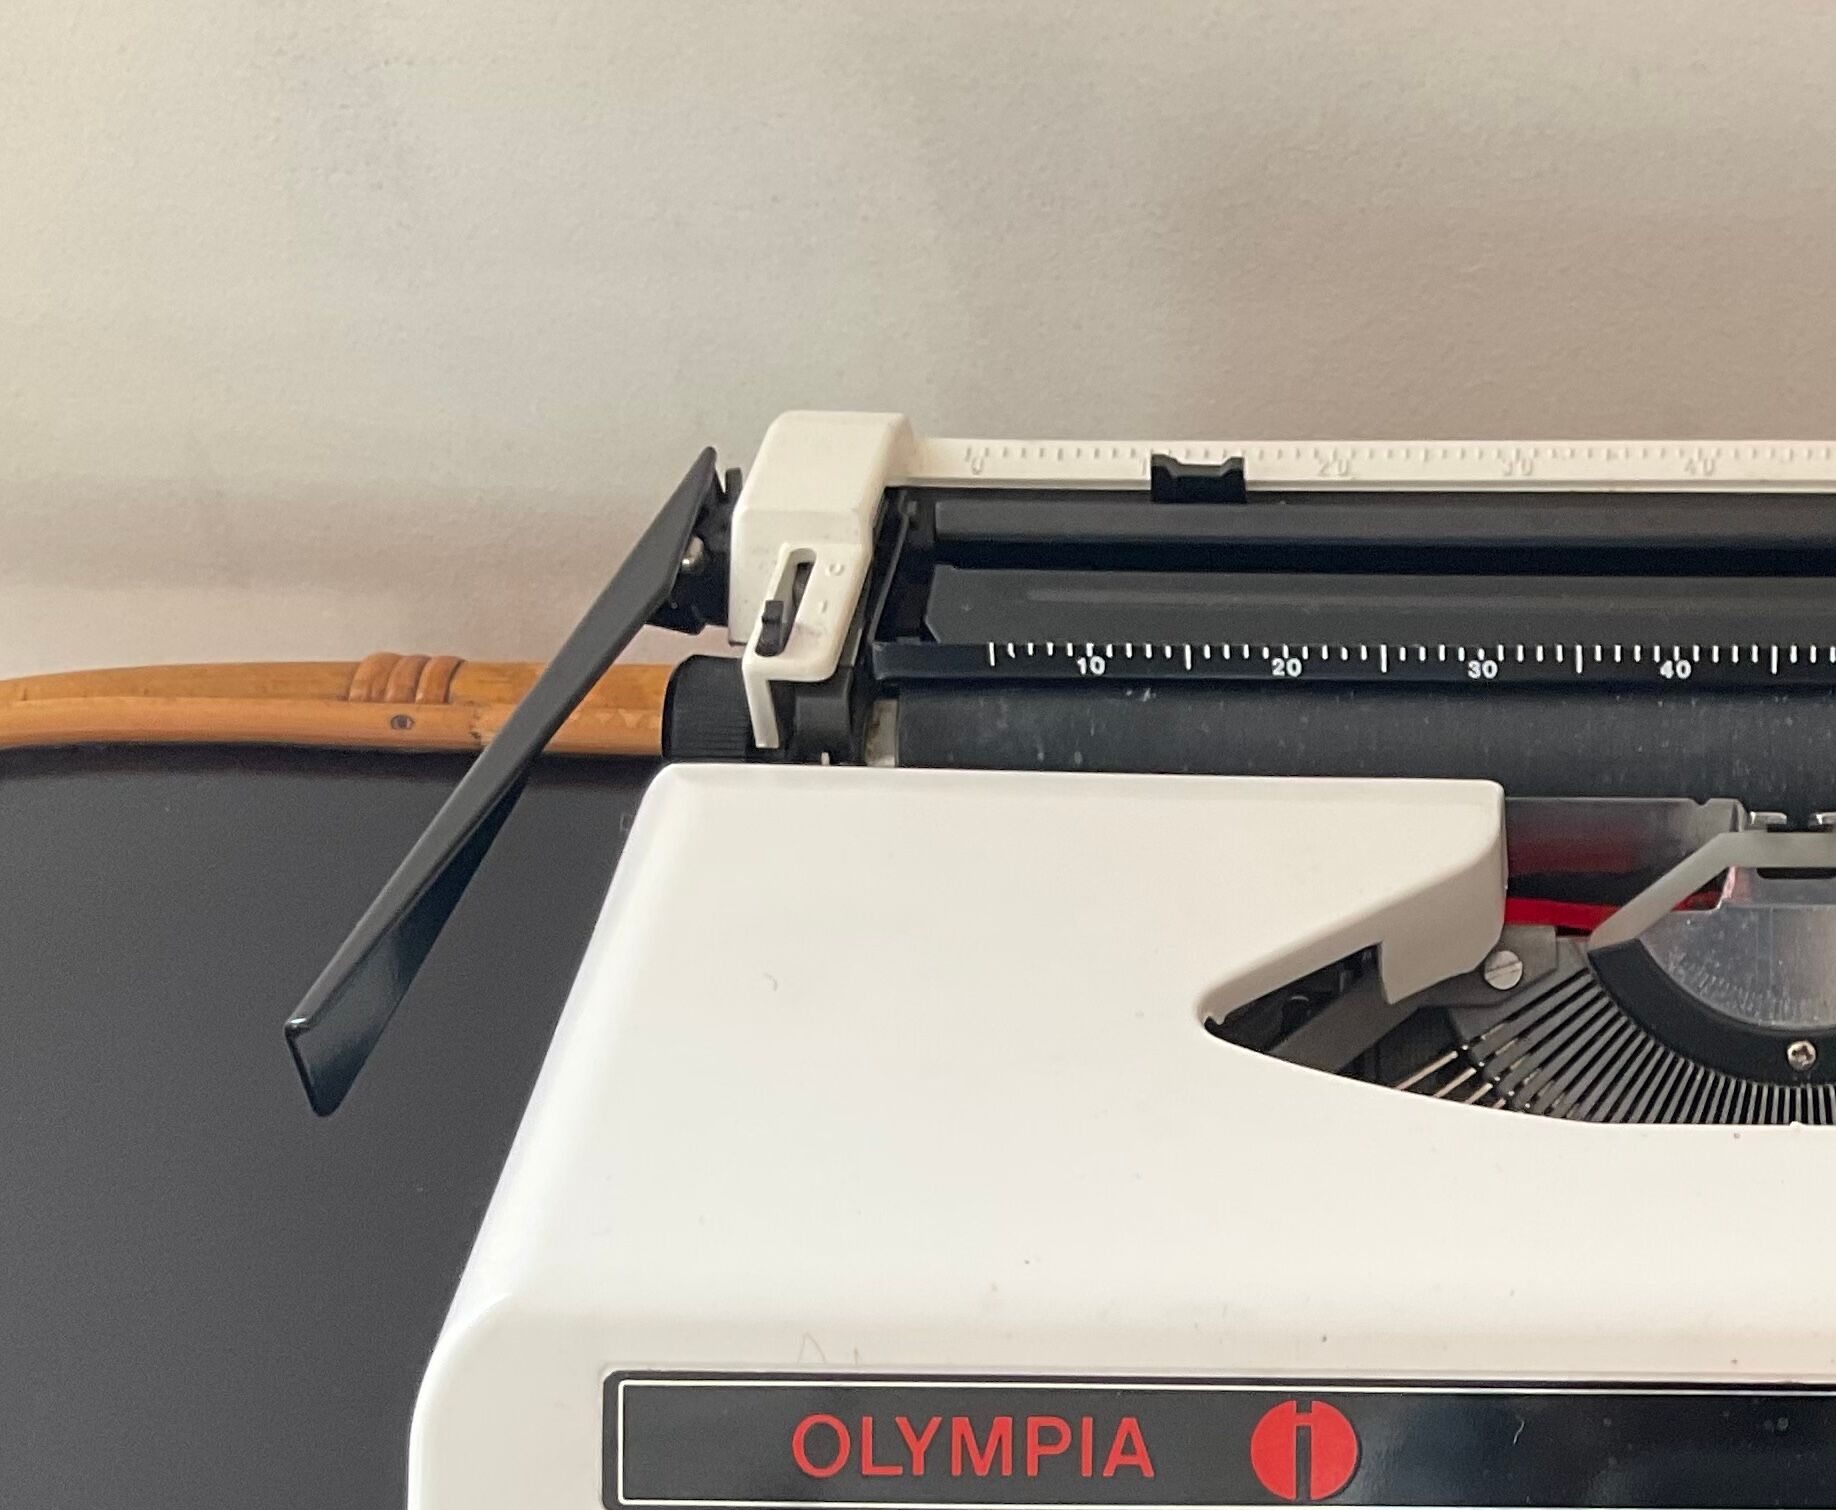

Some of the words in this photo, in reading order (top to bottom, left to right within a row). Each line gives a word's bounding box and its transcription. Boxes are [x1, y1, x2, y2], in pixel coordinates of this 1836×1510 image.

[1076, 656, 1106, 676] 10
[1271, 657, 1302, 678] 20
[1467, 659, 1498, 679] 30
[1659, 659, 1692, 679] 40
[791, 1413, 1155, 1478] OLYMPIA
